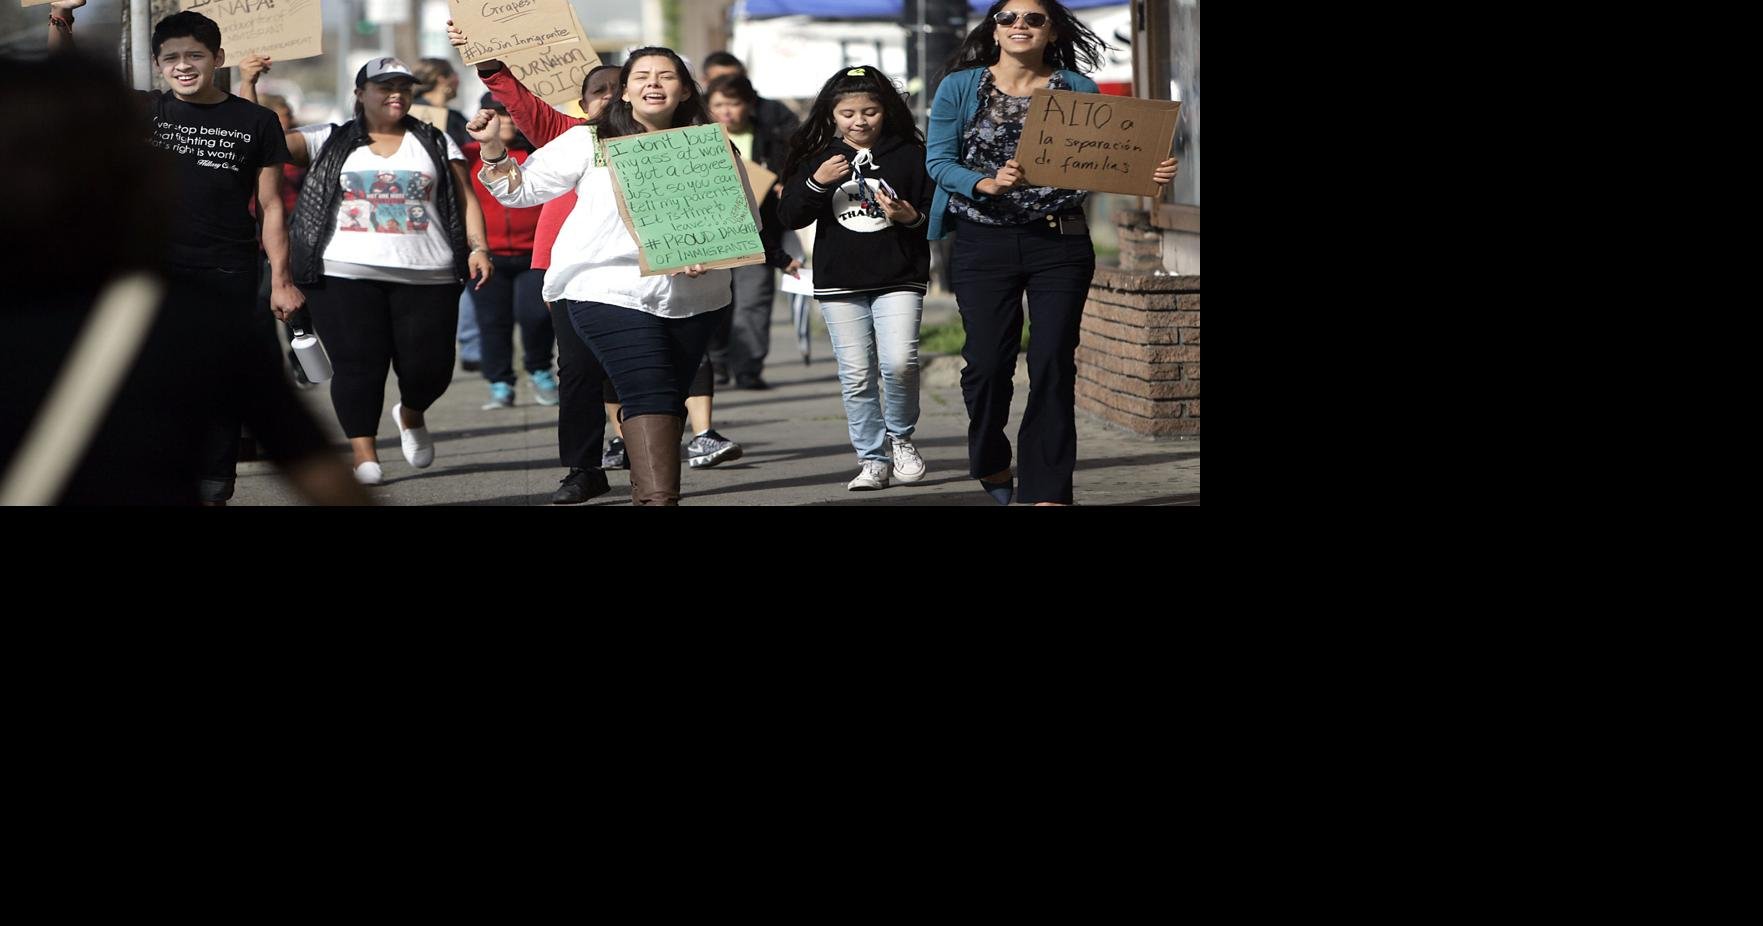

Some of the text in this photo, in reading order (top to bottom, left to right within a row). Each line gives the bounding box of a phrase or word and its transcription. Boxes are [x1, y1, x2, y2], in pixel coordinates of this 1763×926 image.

[1043, 94, 1134, 130] ALTO a
[175, 133, 216, 148] fighting
[219, 139, 235, 149] for
[200, 126, 251, 143] believing
[608, 128, 723, 157] I don't bust
[1039, 130, 1053, 145] la
[173, 144, 195, 154] right
[197, 148, 204, 157] is
[615, 158, 639, 172] my
[641, 152, 672, 164] ass
[677, 146, 697, 160] at
[634, 166, 664, 186] got
[666, 165, 679, 177] a
[1060, 156, 1130, 174] familias
[666, 183, 685, 193] so
[685, 179, 710, 194] you
[713, 174, 737, 185] can
[630, 186, 740, 214] tell my parents
[639, 214, 663, 228] It
[668, 210, 681, 221] is
[681, 206, 712, 219] time
[711, 200, 726, 212] to
[656, 240, 758, 265] OF IMMIGRANTS
